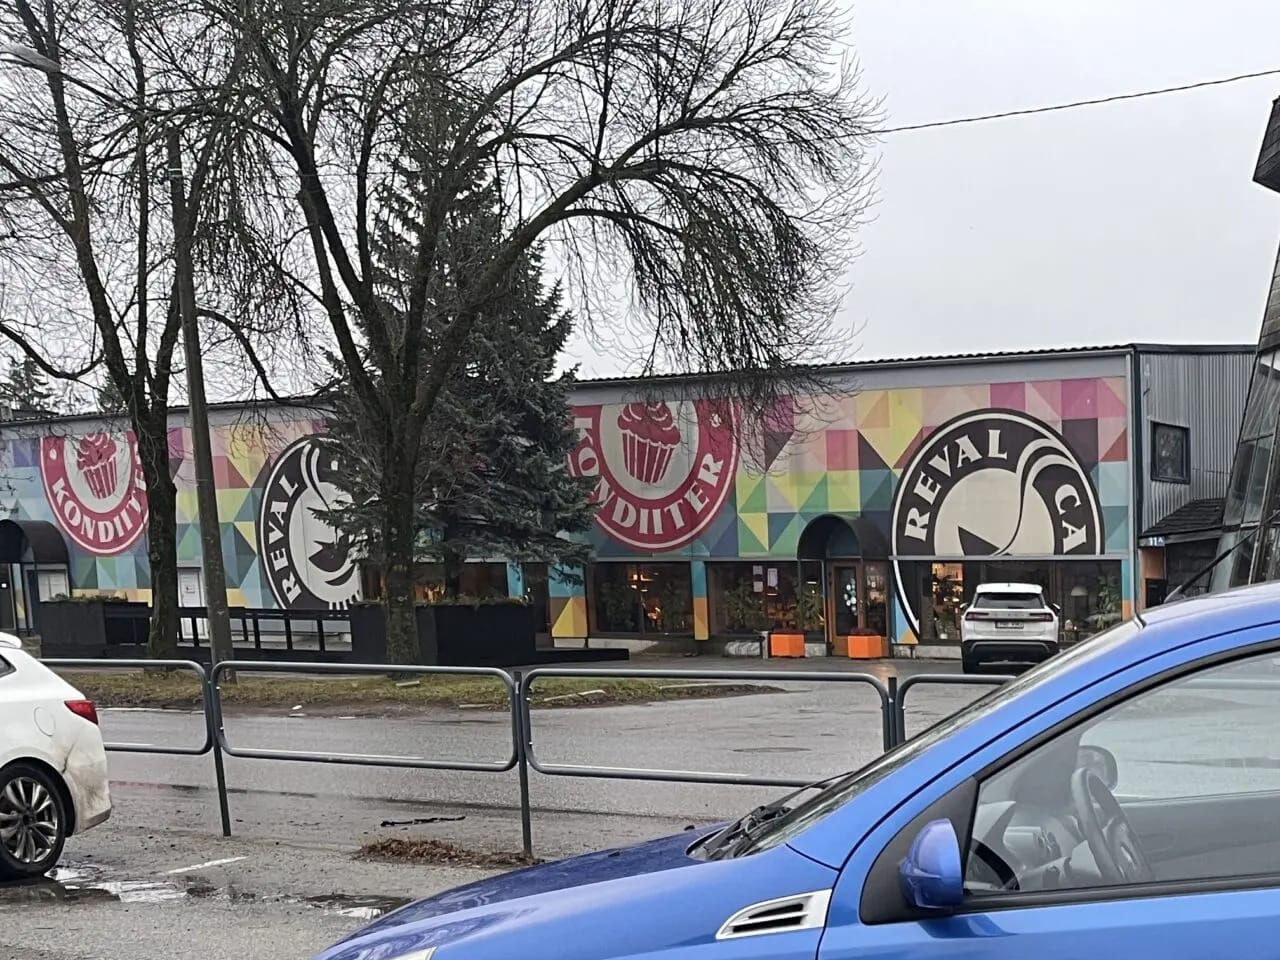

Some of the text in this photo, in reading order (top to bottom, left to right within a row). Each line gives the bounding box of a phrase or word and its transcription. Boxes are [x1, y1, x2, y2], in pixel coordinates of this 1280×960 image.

[268, 475, 302, 604] REVAL
[904, 429, 1087, 553] REVAL CA
